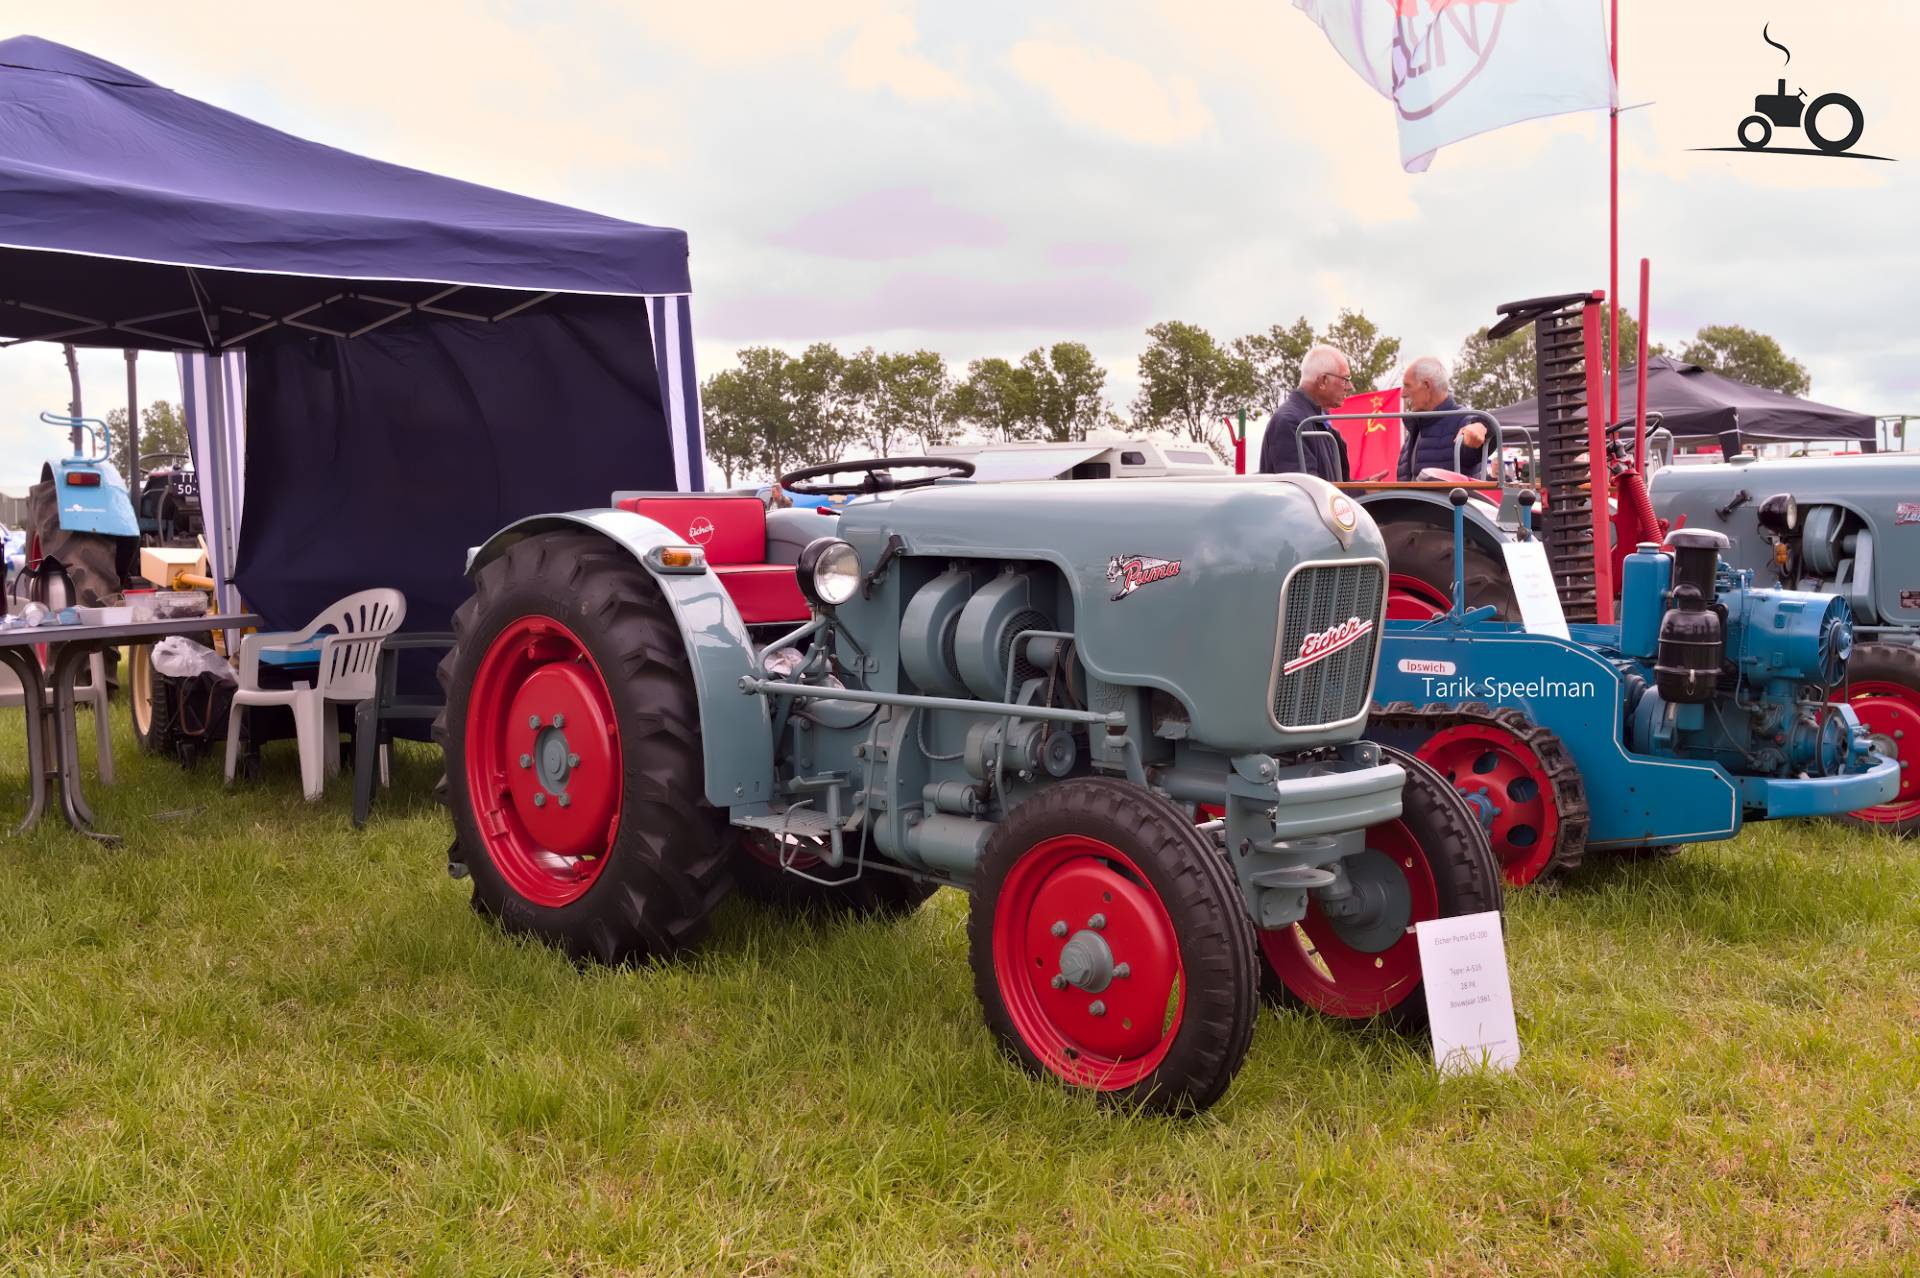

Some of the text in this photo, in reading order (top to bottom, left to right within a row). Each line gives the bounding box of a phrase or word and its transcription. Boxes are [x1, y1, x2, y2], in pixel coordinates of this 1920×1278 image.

[180, 473, 198, 484] TT
[177, 485, 200, 495] 50-
[1122, 559, 1181, 592] Puma
[1299, 616, 1361, 659] Eicher
[1407, 661, 1446, 674] Ipswich
[1452, 935, 1469, 944] Puma
